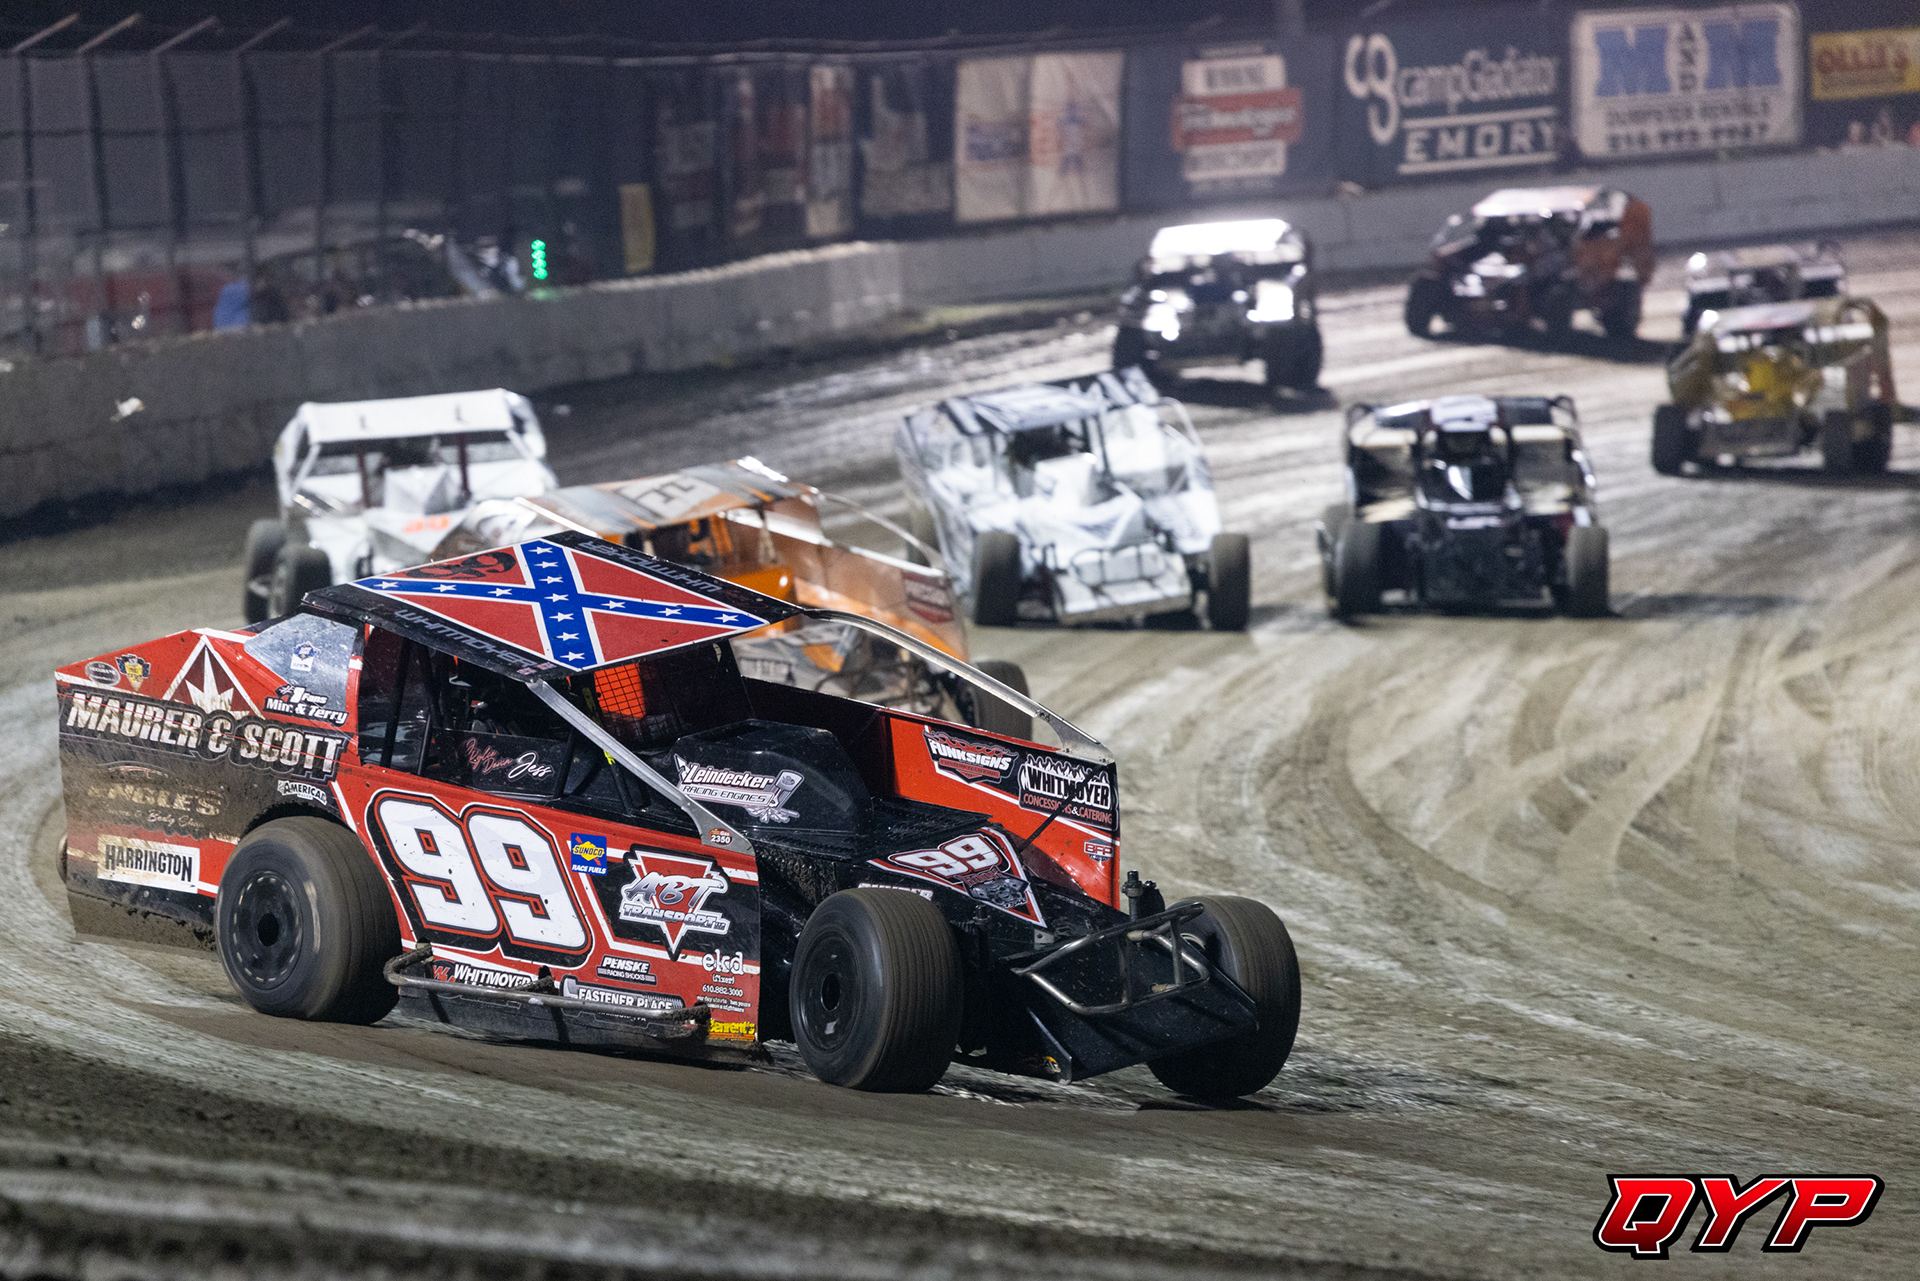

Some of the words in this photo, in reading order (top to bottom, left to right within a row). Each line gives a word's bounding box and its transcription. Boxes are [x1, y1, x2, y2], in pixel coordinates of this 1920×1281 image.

[1595, 24, 1670, 97] M
[1704, 18, 1781, 89] M
[1404, 121, 1555, 163] EMORY
[301, 692, 328, 704] Fans
[295, 703, 306, 715] &
[308, 705, 348, 724] Terry
[67, 692, 202, 749] MAURER
[240, 723, 341, 774] SCOTT
[508, 752, 552, 779] Jess
[929, 739, 1012, 770] FUNKSIGNS
[682, 764, 774, 789] Leindecker
[682, 785, 718, 797] RACING
[721, 791, 767, 803] ENGINES
[572, 845, 604, 857] SUNOCO
[710, 834, 731, 844] 2350
[105, 844, 193, 883] HARRINGTON
[571, 863, 588, 873] RACE
[588, 866, 607, 875] FUELS
[894, 835, 1000, 877] 99
[379, 797, 588, 946] 99
[624, 871, 725, 908] ABT
[623, 904, 717, 930] TRANSPORT
[602, 957, 649, 973] PENSKE
[578, 988, 634, 1006] FASTENER
